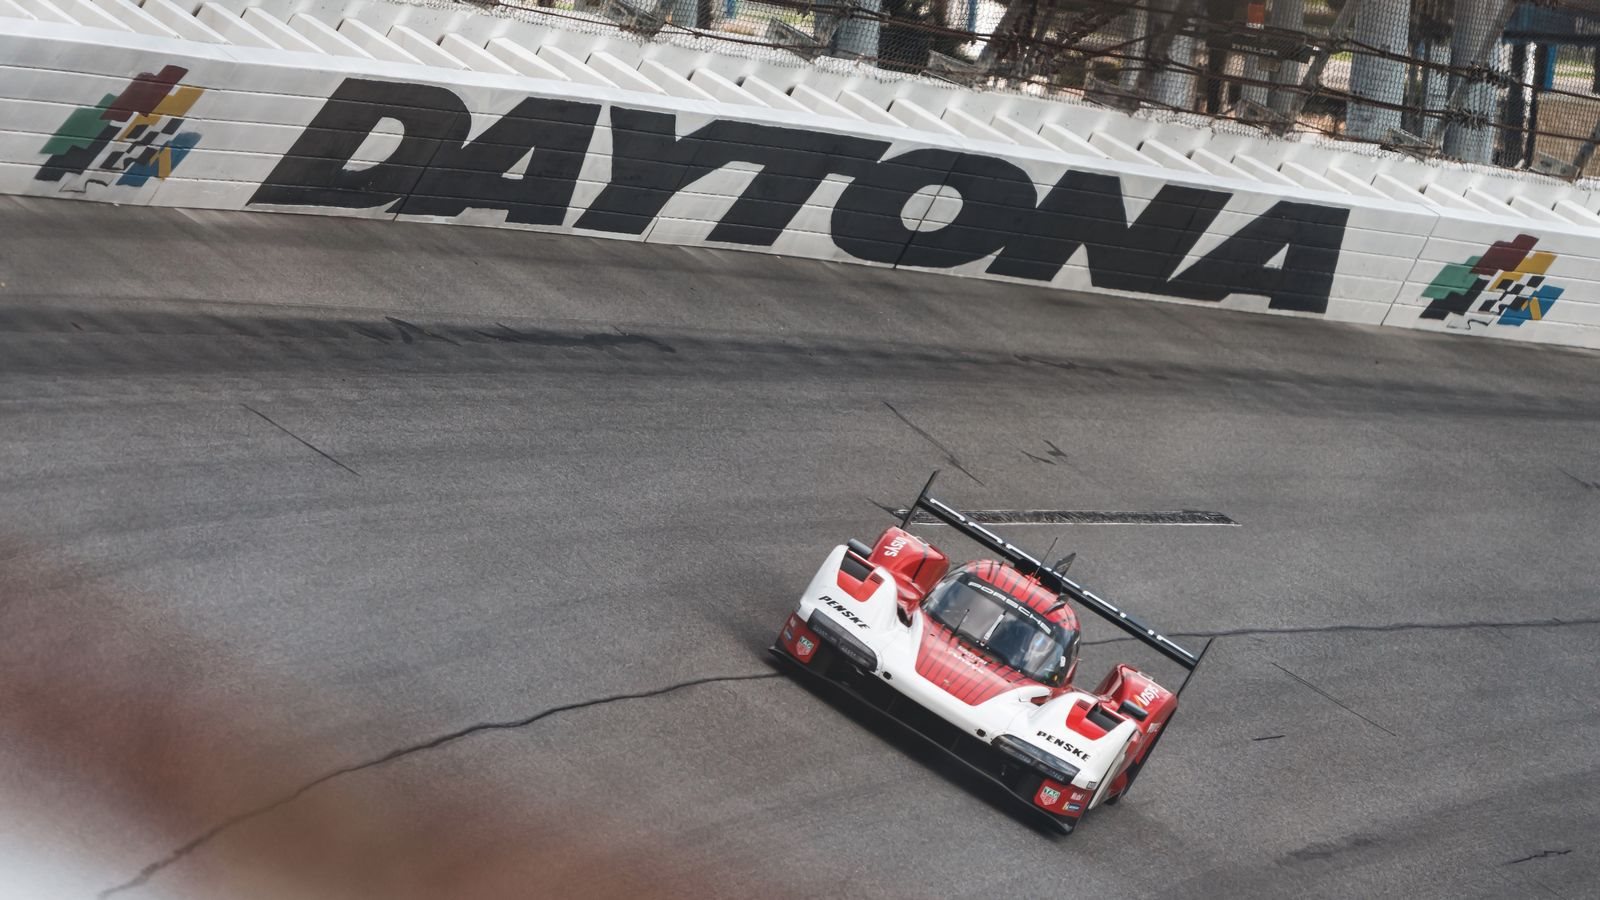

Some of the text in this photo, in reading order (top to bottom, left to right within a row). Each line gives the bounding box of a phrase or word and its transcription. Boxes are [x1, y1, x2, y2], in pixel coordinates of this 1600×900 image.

[245, 77, 1350, 313] DAYTONA
[818, 595, 871, 629] PENSKE
[967, 581, 1052, 635] PORSCHE
[1036, 730, 1091, 762] PENSKE
[1044, 787, 1059, 797] TAG
